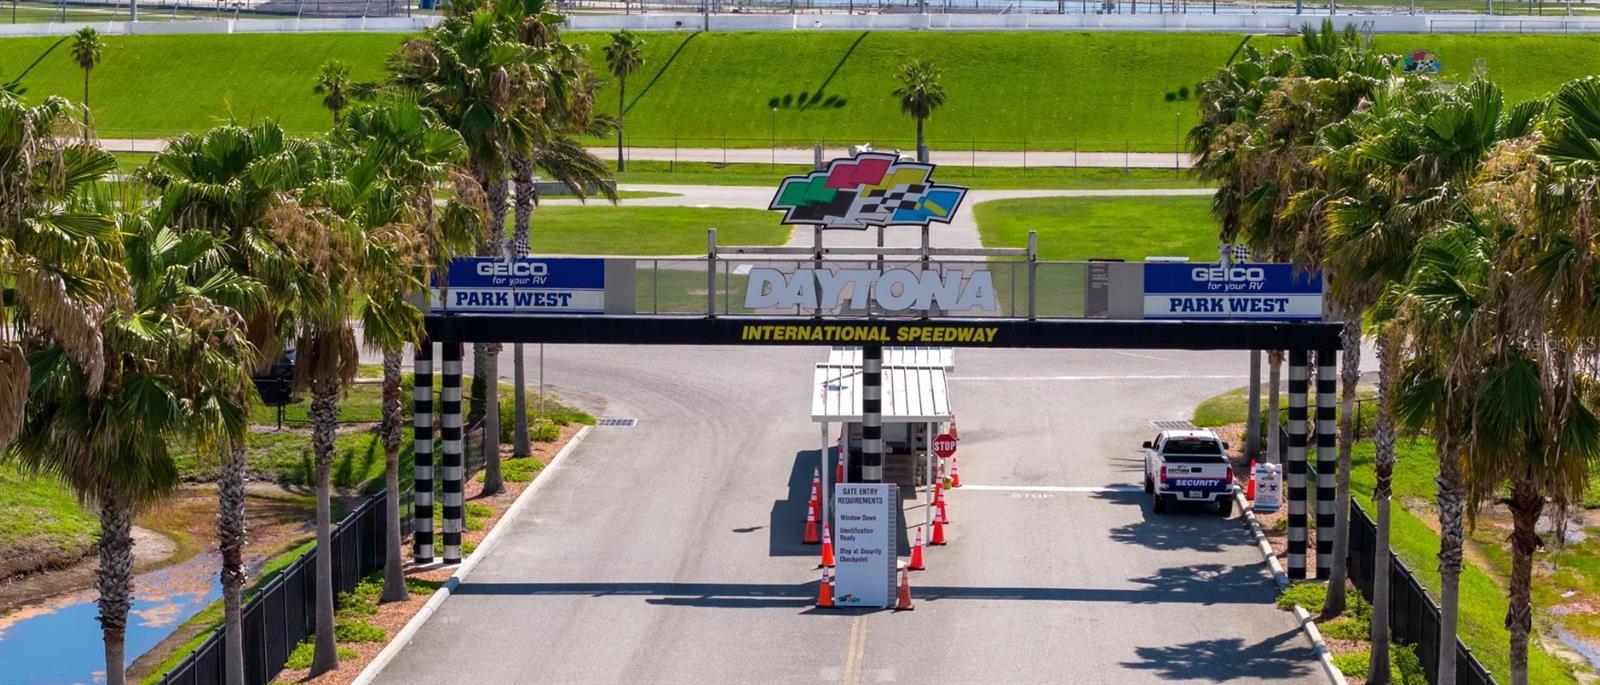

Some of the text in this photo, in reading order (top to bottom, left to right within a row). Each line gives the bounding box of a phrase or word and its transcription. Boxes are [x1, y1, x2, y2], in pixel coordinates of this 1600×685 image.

[476, 262, 547, 276] GEICO
[1191, 267, 1265, 282] GEICO
[492, 276, 547, 286] for your RV
[1207, 282, 1264, 292] for your RV
[744, 268, 997, 311] DAYTONA
[455, 292, 572, 307] PARK WEST
[1169, 298, 1289, 313] PARK WEST
[741, 325, 999, 343] INTERNATIONAL SPEEDWAY
[934, 441, 956, 451] STOP
[1176, 479, 1220, 487] SECURITY
